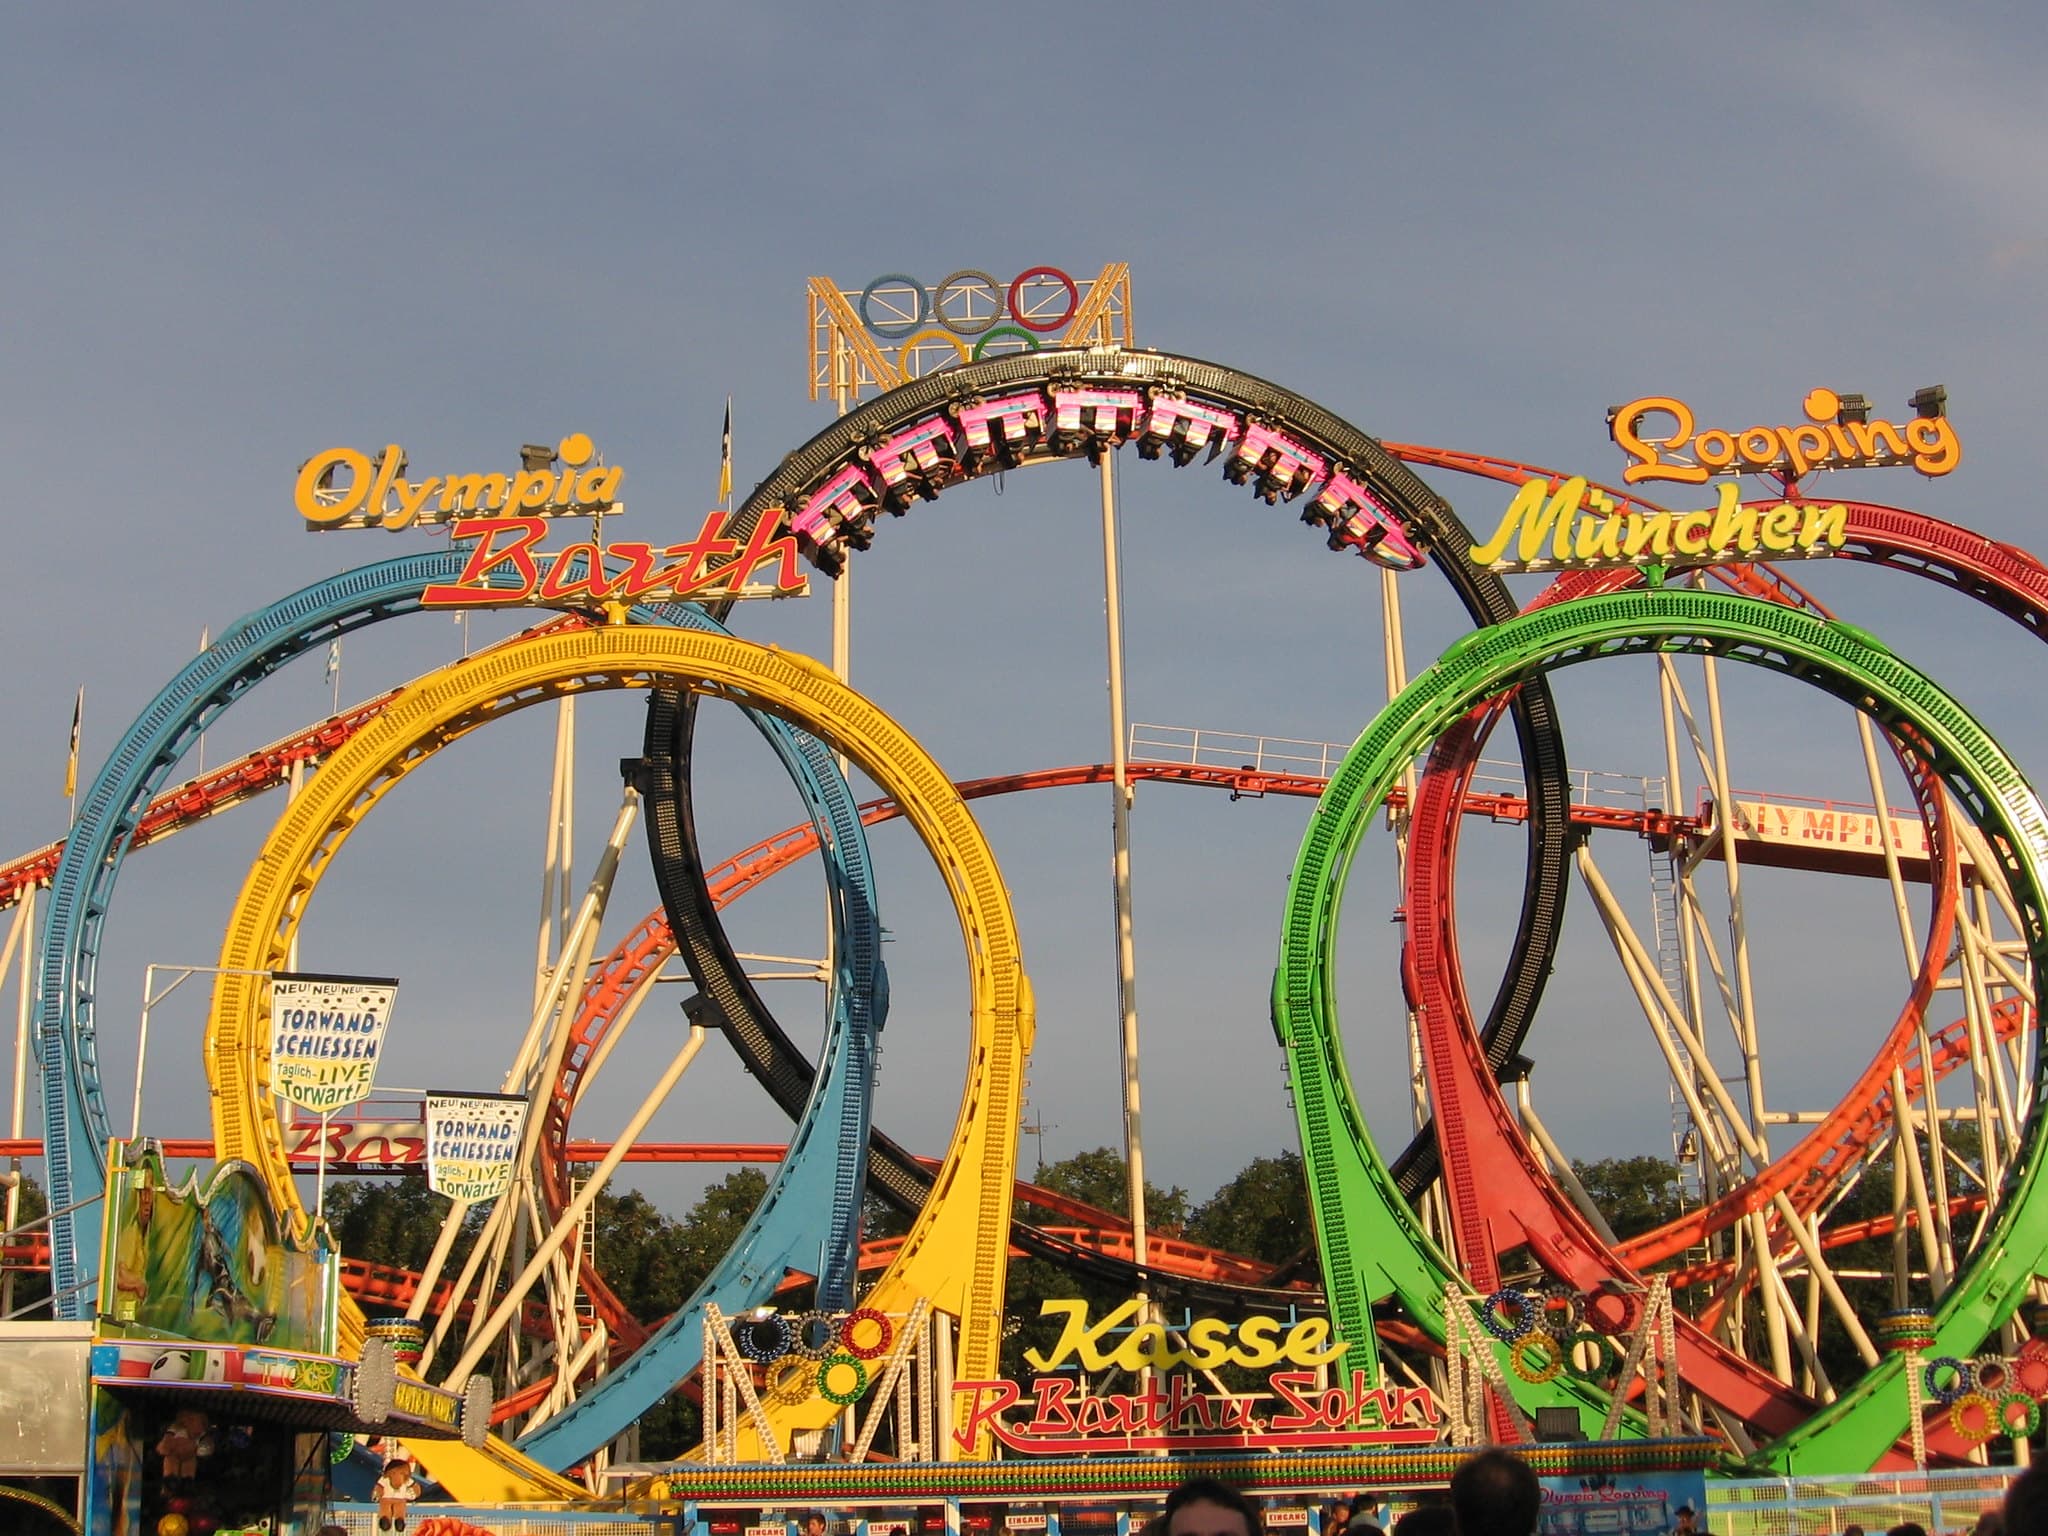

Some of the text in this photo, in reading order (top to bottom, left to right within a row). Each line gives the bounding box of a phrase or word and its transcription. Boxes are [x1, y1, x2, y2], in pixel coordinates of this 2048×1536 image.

[1613, 387, 1961, 485] Looping
[294, 432, 625, 531] Olympia
[1469, 476, 1849, 564] München
[419, 508, 809, 605] Barth
[1731, 804, 1903, 849] OLYMPIA
[274, 983, 311, 995] NEU!
[313, 984, 341, 995] NEU!
[281, 1008, 382, 1035] TORWAND-
[274, 1034, 378, 1060] SCHIESSEN
[319, 1062, 371, 1085] LIVE
[281, 1079, 362, 1106] Torwart!
[429, 1099, 458, 1109] NEU!
[435, 1119, 517, 1140] TORWAND-
[433, 1141, 513, 1161] SCHIESSEN
[468, 1163, 508, 1183] LIVE
[436, 1177, 502, 1199] Torwart!
[1023, 1299, 1350, 1372] Kasse
[1008, 1516, 1046, 1525] EINGANG
[1269, 1513, 1306, 1521] EINGANG
[747, 1528, 785, 1536] EINGANG
